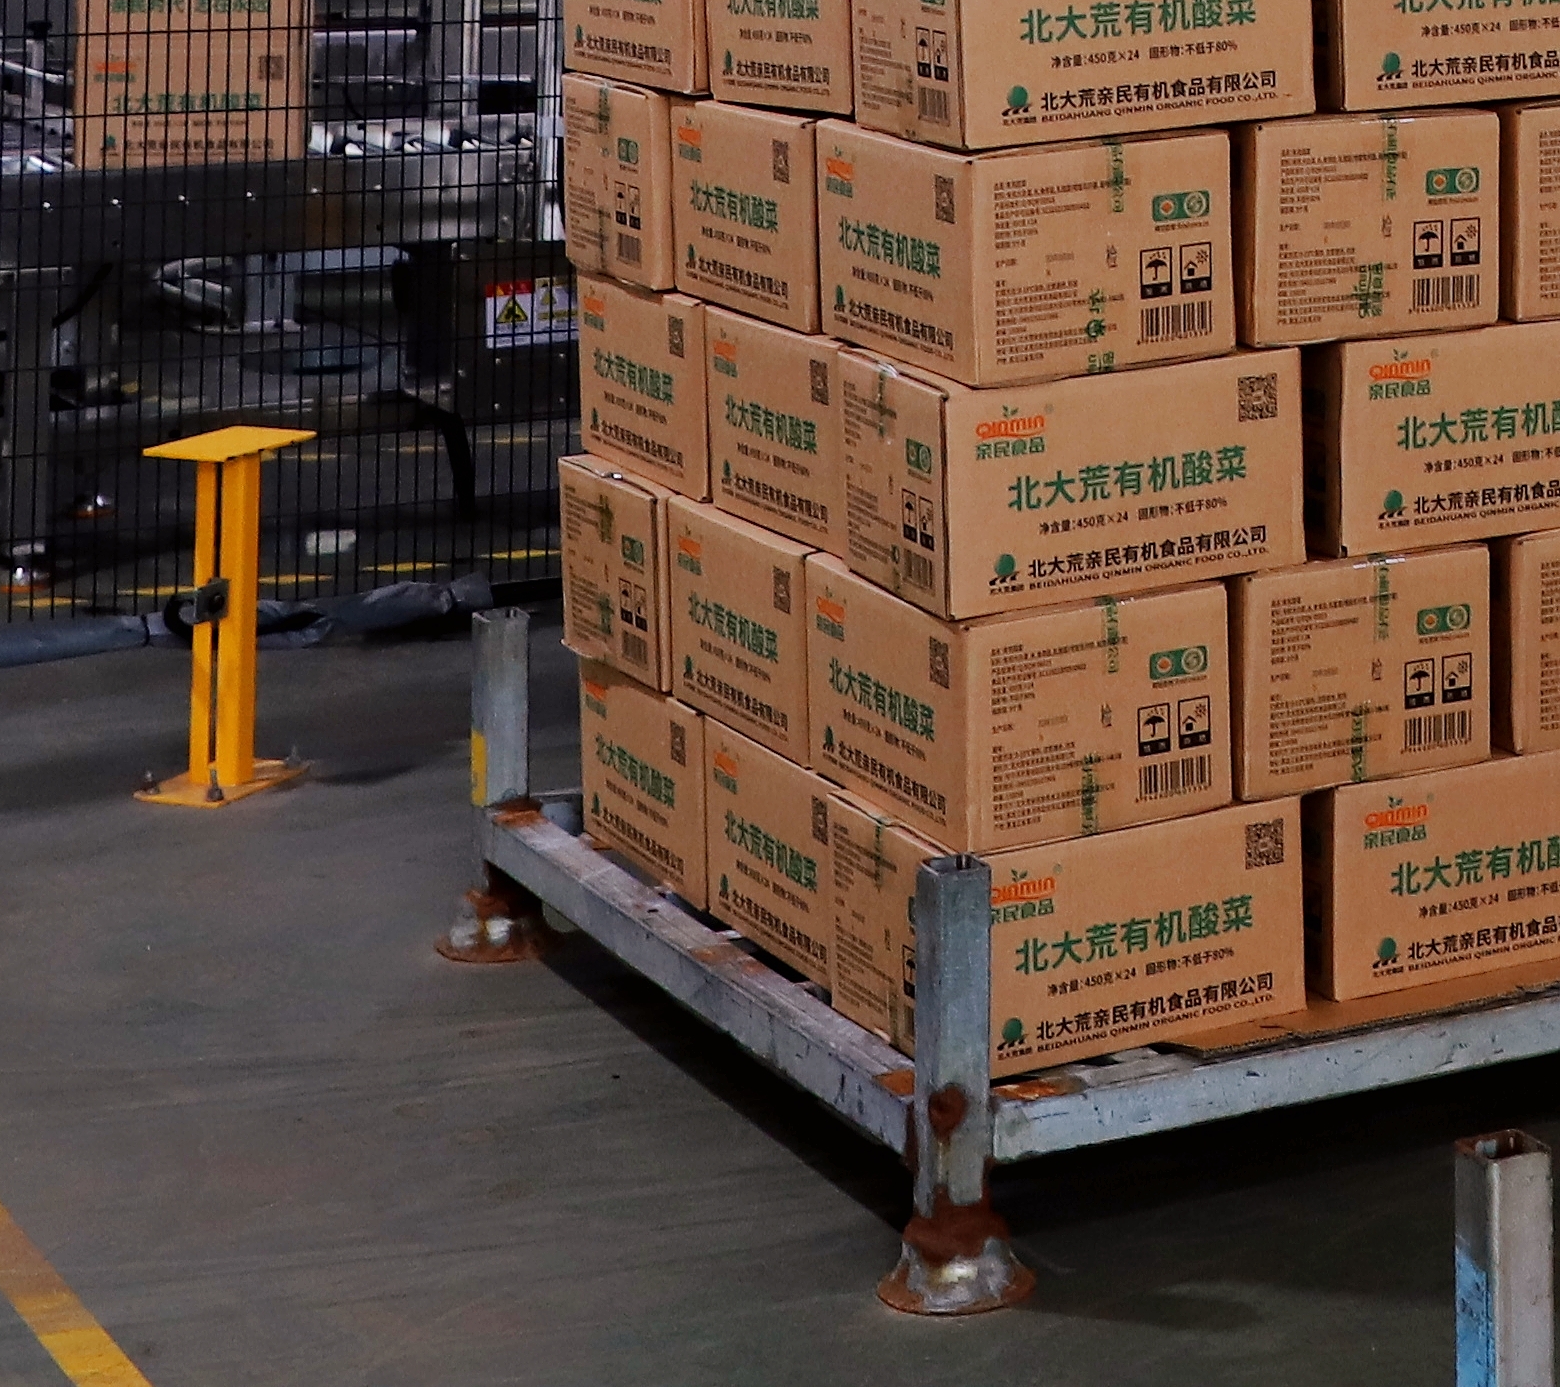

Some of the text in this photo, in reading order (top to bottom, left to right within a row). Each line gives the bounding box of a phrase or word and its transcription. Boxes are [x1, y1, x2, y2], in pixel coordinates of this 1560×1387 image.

[1040, 69, 1276, 111] 北大荒亲民有机食品有限公司
[1477, 74, 1512, 84] QINMIN
[1515, 70, 1557, 80] ORGANIC
[1041, 108, 1111, 122] BEIDAHUANG
[1114, 103, 1153, 116] QINMIN
[1156, 99, 1202, 110] ORGANIC
[1205, 95, 1235, 105] FOOD
[689, 178, 778, 234] 北大荒有机酸菜
[837, 214, 941, 280] 北大荒有机酸菜
[1369, 378, 1430, 400] 亲民食品
[724, 392, 816, 456] 北大荒有机酸菜
[976, 435, 1044, 461] 亲民食品
[1008, 444, 1247, 513] 北大荒有机酸菜
[1479, 505, 1514, 518] QINMIN
[1517, 500, 1559, 512] ORGANIC
[1028, 524, 1266, 579] 北大荒亲民有机食品有限公司
[1029, 572, 1099, 589] BEIDAHUANG
[1102, 565, 1142, 579] QINMIN
[1145, 557, 1192, 571] ORGANIC
[1195, 552, 1224, 563] FOOD
[688, 589, 778, 665] 北大荒有机酸菜
[828, 654, 935, 743] 北大荒有机酸菜
[724, 806, 816, 895] 北大荒有机酸菜
[1016, 892, 1254, 977] 北大荒有机酸菜
[1036, 971, 1273, 1041] 北大荒亲民有机食品有限公司
[1037, 1029, 1106, 1051] BEIDAHUANG
[1110, 1020, 1149, 1036] QINMIN
[1152, 1009, 1199, 1026] ORGANIC
[1201, 1002, 1231, 1015] FOOD
